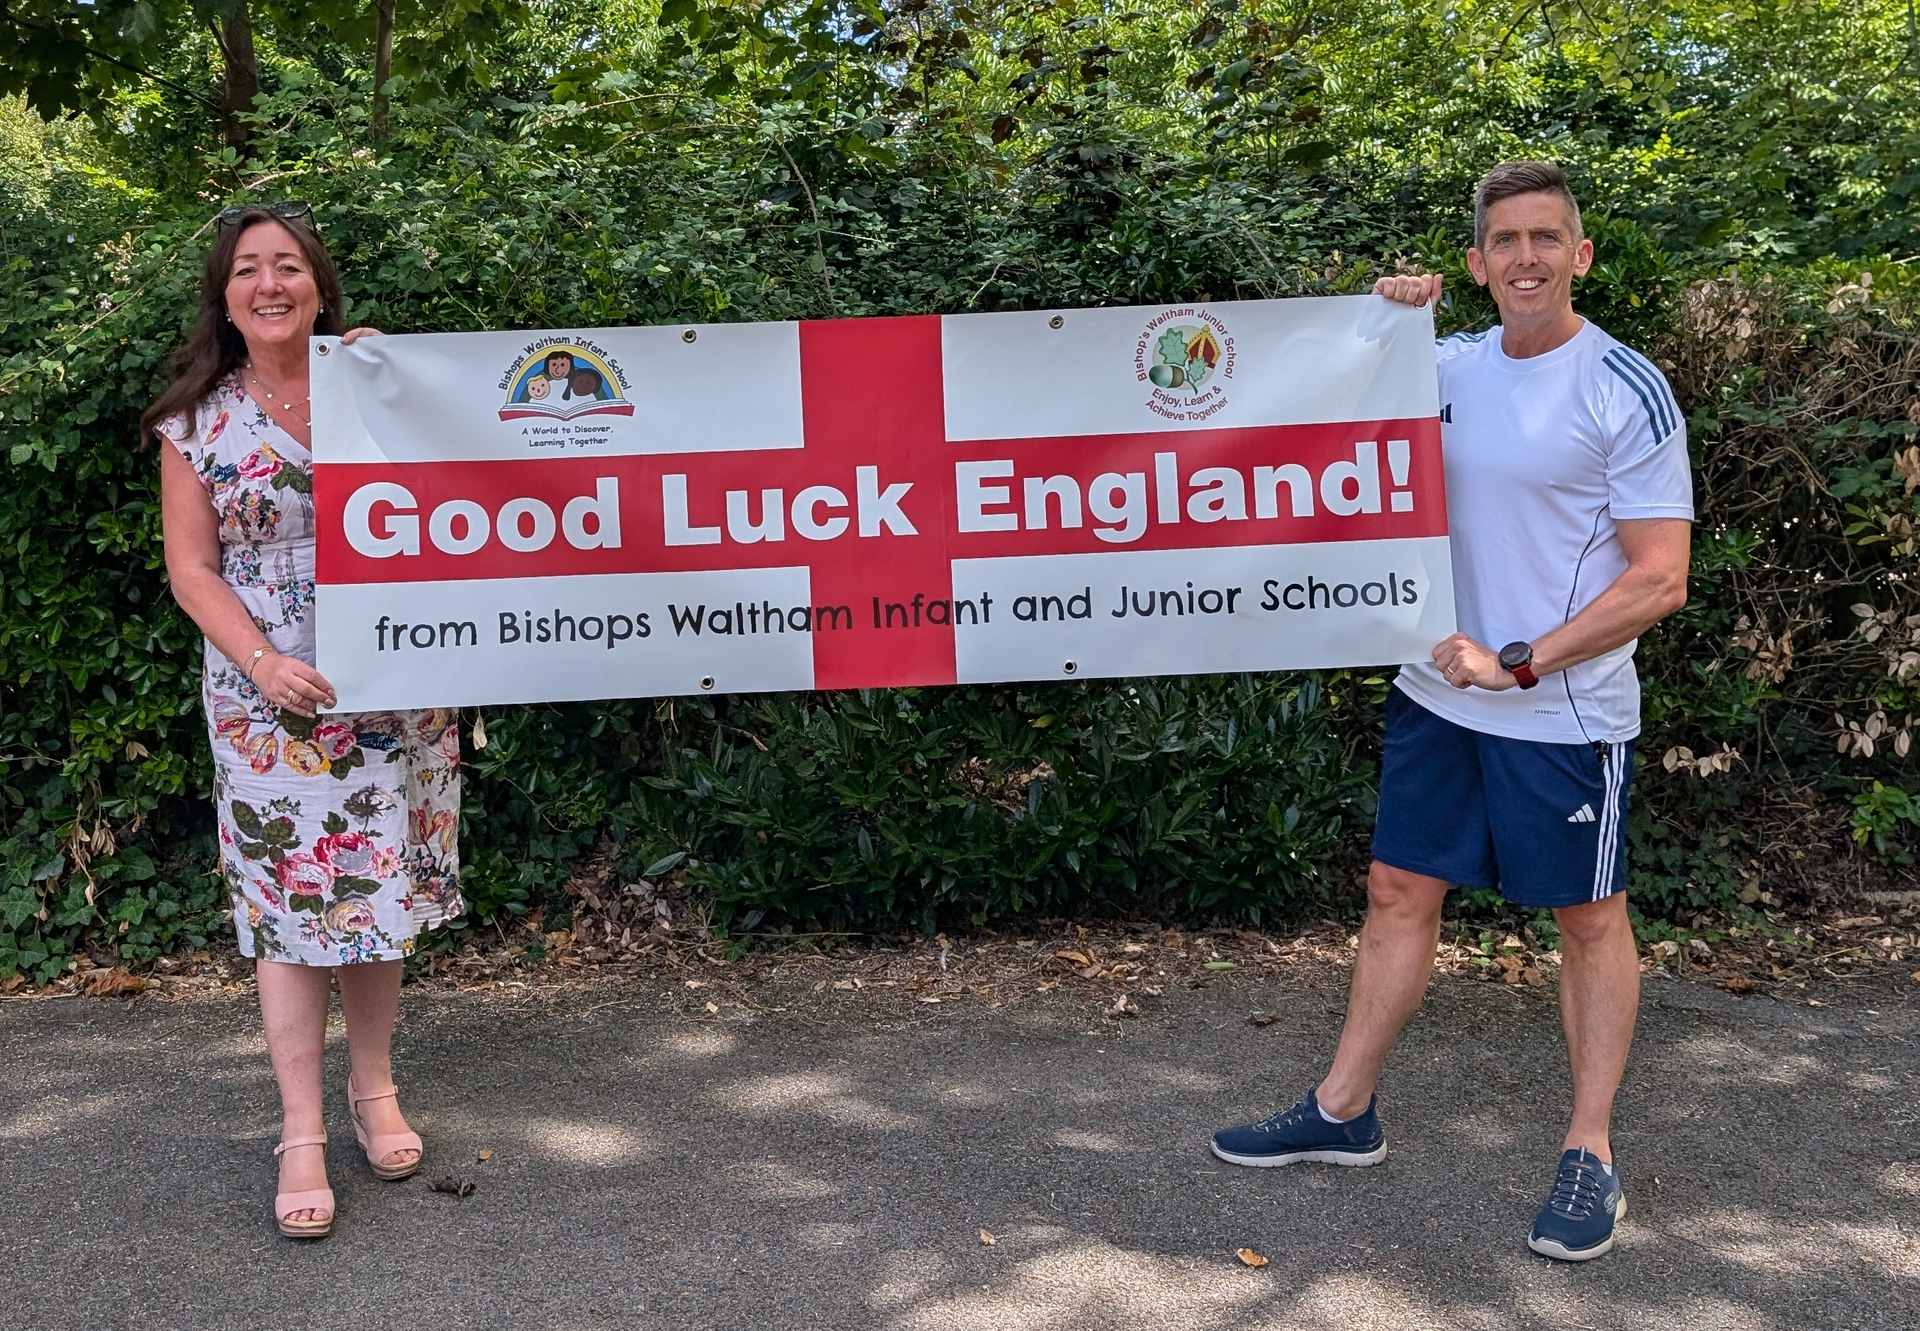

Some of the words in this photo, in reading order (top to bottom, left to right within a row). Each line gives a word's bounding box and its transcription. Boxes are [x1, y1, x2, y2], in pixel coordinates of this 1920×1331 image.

[498, 354, 525, 391] Bishops
[523, 336, 570, 355] Waltham
[574, 336, 608, 359] Infant
[607, 358, 632, 391] School
[1134, 332, 1151, 382] Bishop's
[1146, 308, 1194, 331] Waltham
[1197, 310, 1229, 336] Junior
[1223, 337, 1237, 379] School
[1145, 400, 1185, 421] Achieve
[1186, 396, 1229, 421] Together
[1152, 388, 1182, 408] Enjoy,
[1184, 392, 1214, 407] Learn
[1212, 385, 1222, 395] &
[529, 438, 566, 448] Learning
[569, 437, 608, 447] Together
[532, 427, 558, 435] World
[561, 426, 571, 434] to
[575, 425, 614, 434] Discover,
[343, 476, 622, 559] Good
[662, 465, 919, 546] Luck
[955, 439, 1414, 543] England!
[375, 615, 478, 651] from
[498, 608, 652, 651] Bishops
[667, 600, 853, 638] Waltham
[872, 591, 994, 629] Infant
[1012, 586, 1093, 622] and
[1111, 581, 1242, 619] Junior
[1260, 572, 1419, 612] Schools
